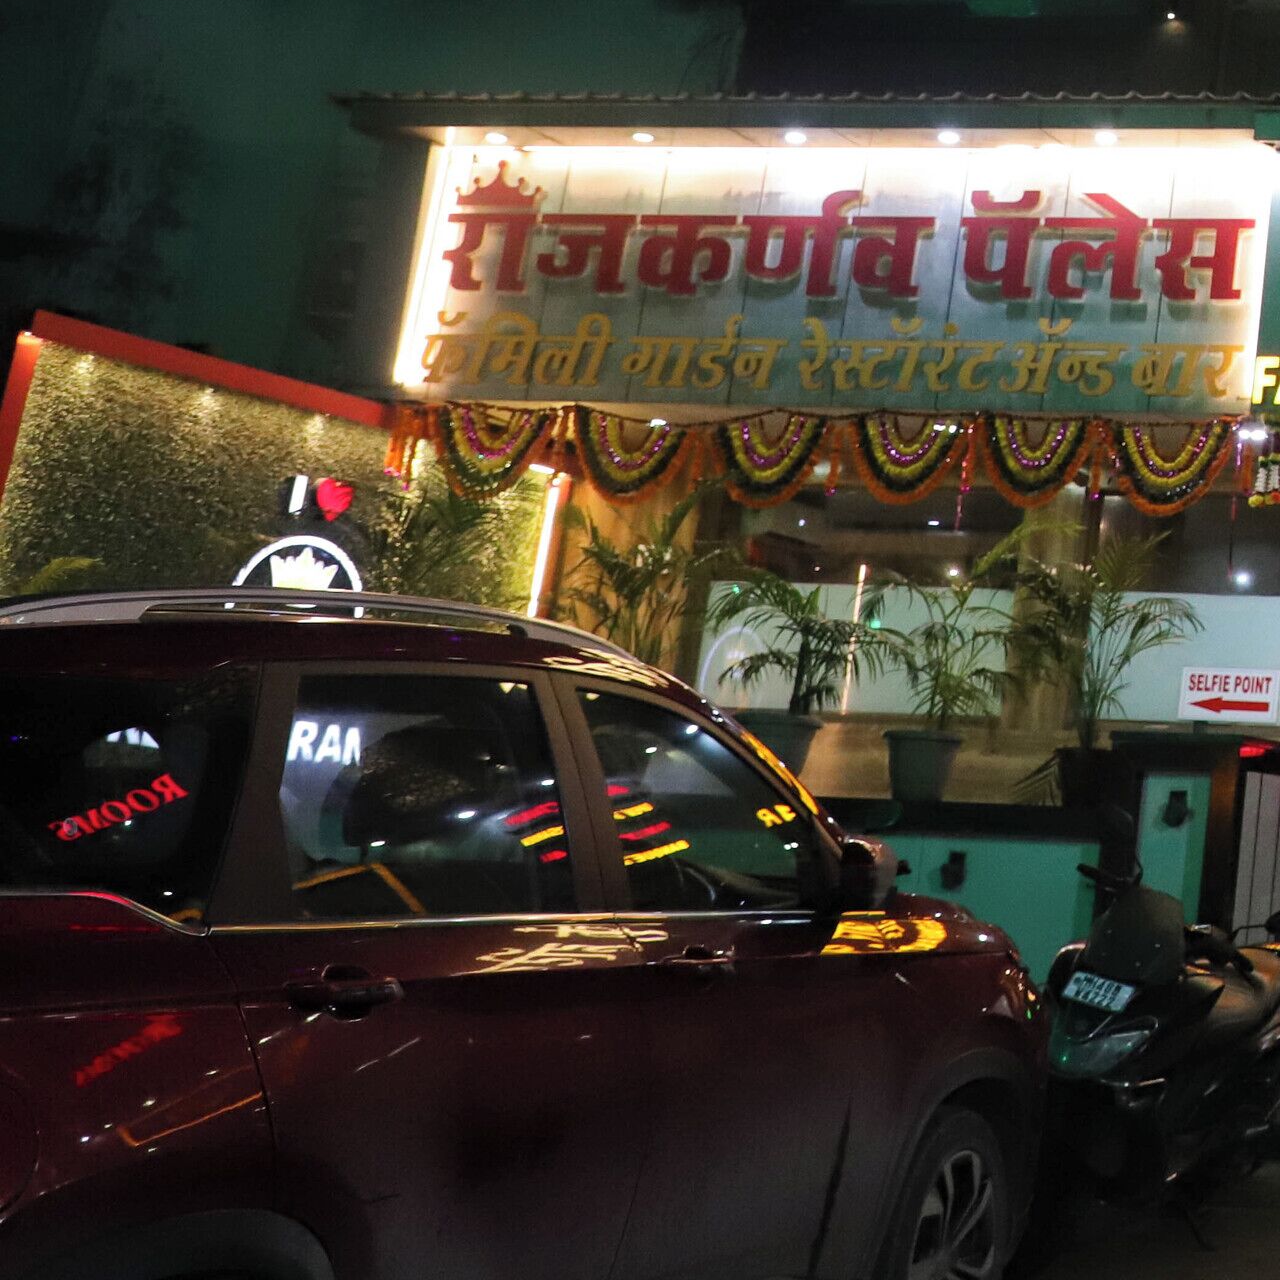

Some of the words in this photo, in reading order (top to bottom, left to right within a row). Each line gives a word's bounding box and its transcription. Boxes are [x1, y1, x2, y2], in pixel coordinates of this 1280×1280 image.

[961, 190, 1256, 300] पॅलेस
[620, 313, 787, 391] गार्डन
[1131, 343, 1244, 398] बार
[1188, 673, 1231, 693] SELFIE
[1234, 675, 1273, 694] POINT
